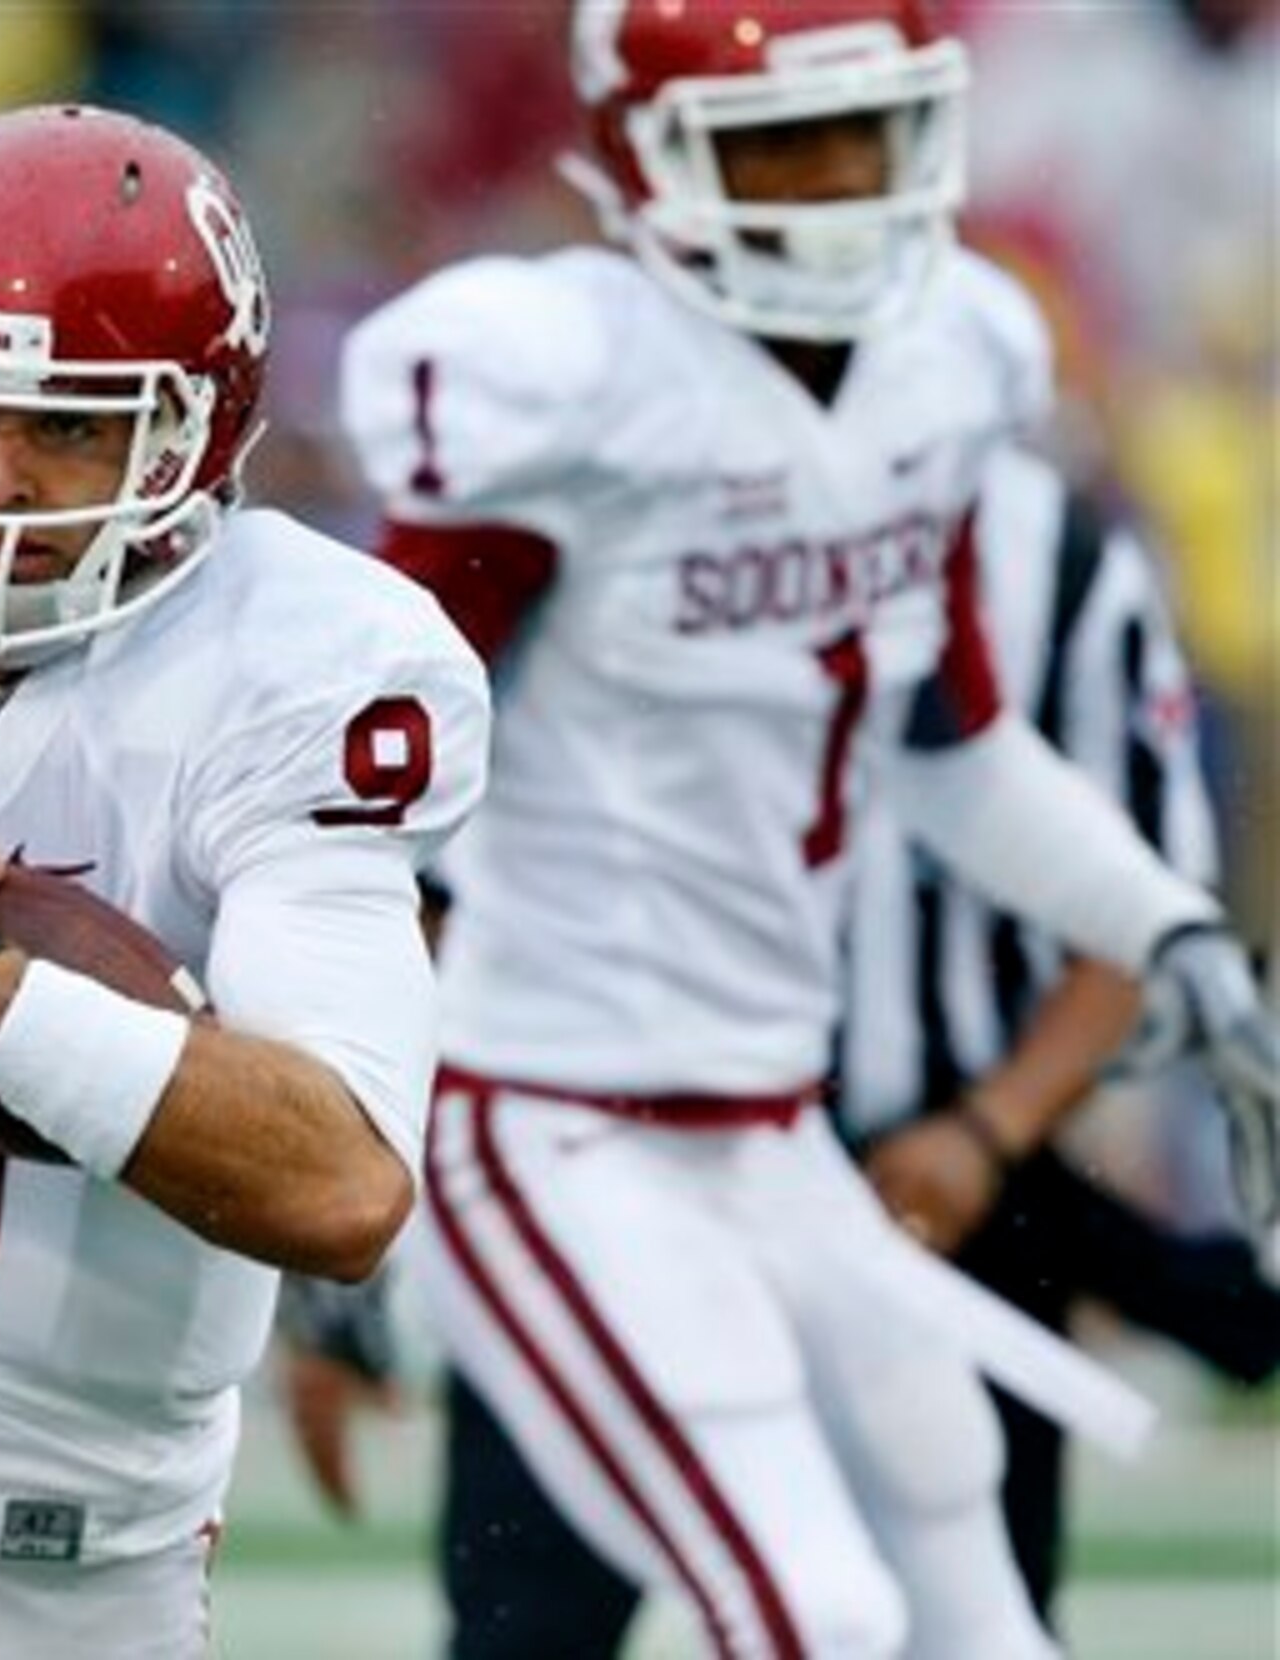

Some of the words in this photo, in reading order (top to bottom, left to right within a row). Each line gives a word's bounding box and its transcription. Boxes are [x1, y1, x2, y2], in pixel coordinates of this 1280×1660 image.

[409, 358, 444, 495] 1
[309, 695, 433, 826] 9
[803, 630, 868, 870] 1
